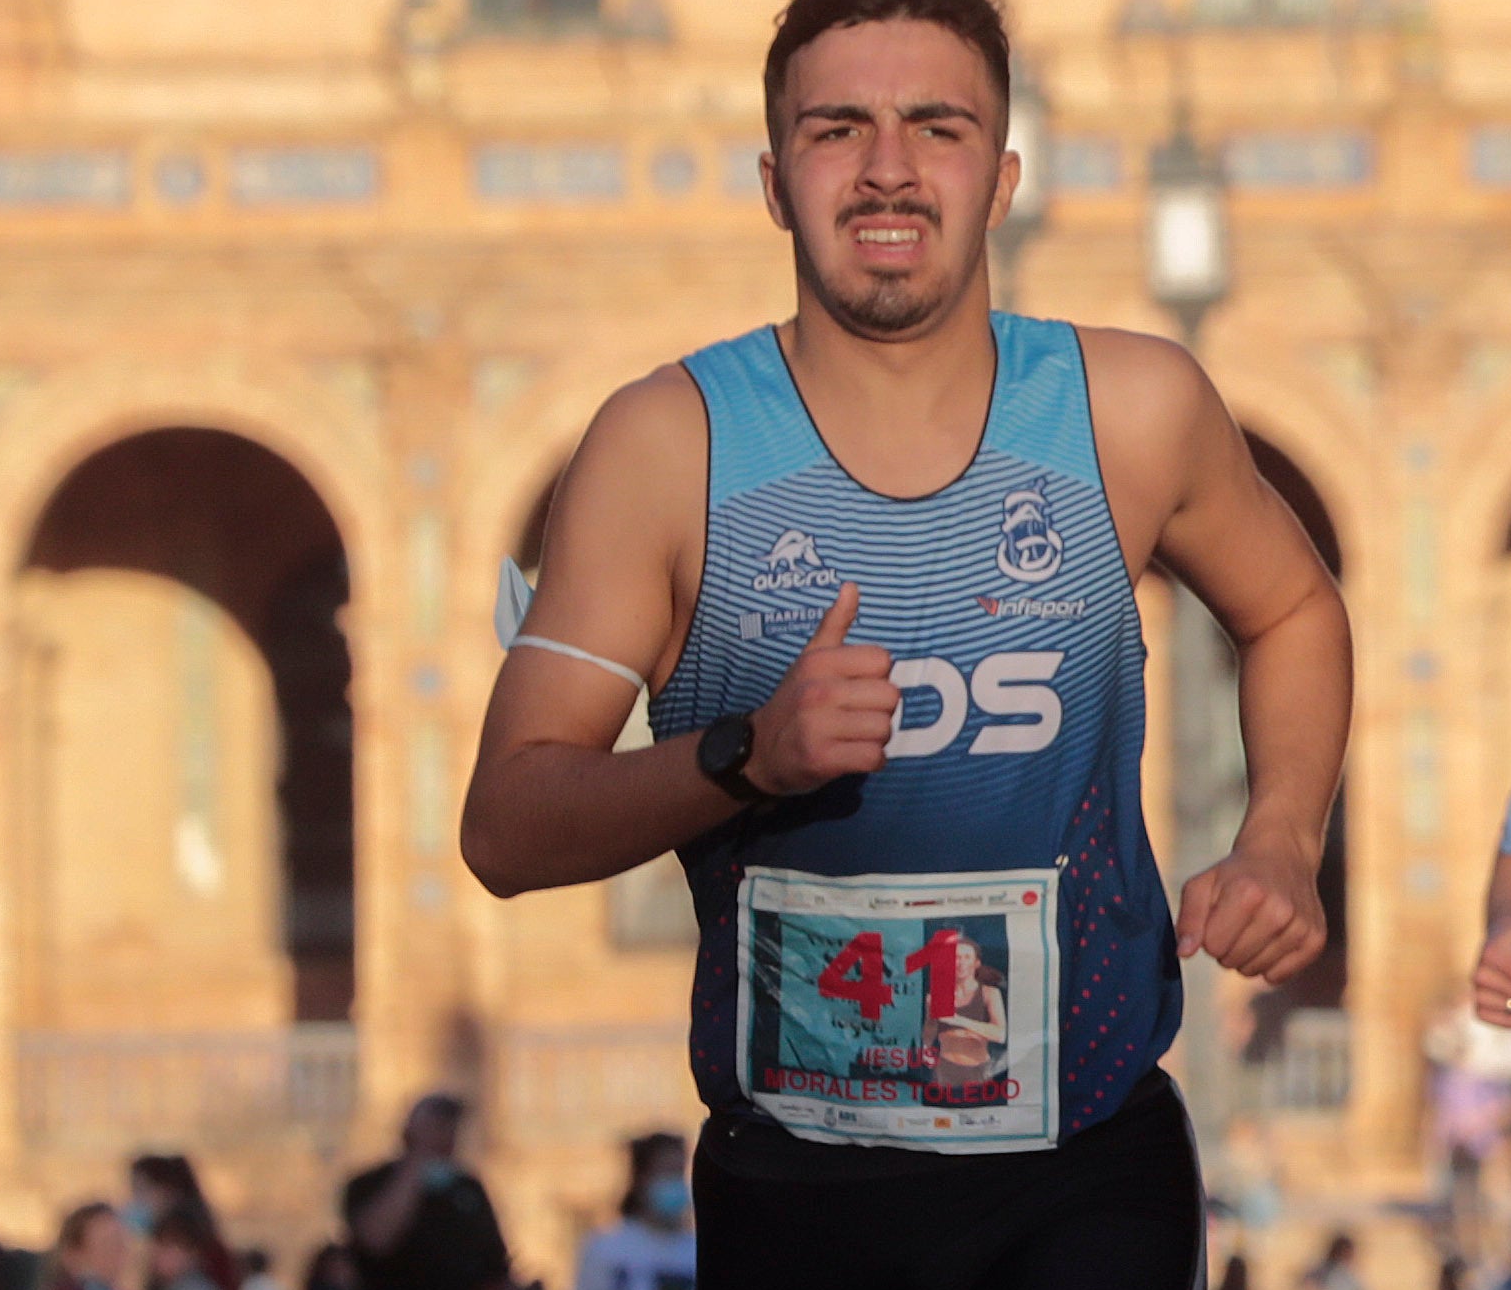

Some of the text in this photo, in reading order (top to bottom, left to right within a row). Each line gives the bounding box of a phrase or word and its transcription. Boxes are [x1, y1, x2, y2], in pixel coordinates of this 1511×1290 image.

[817, 929, 958, 1022] 41
[856, 1044, 940, 1070] JESUS
[763, 1066, 1022, 1105] MORALES TOLEDO
